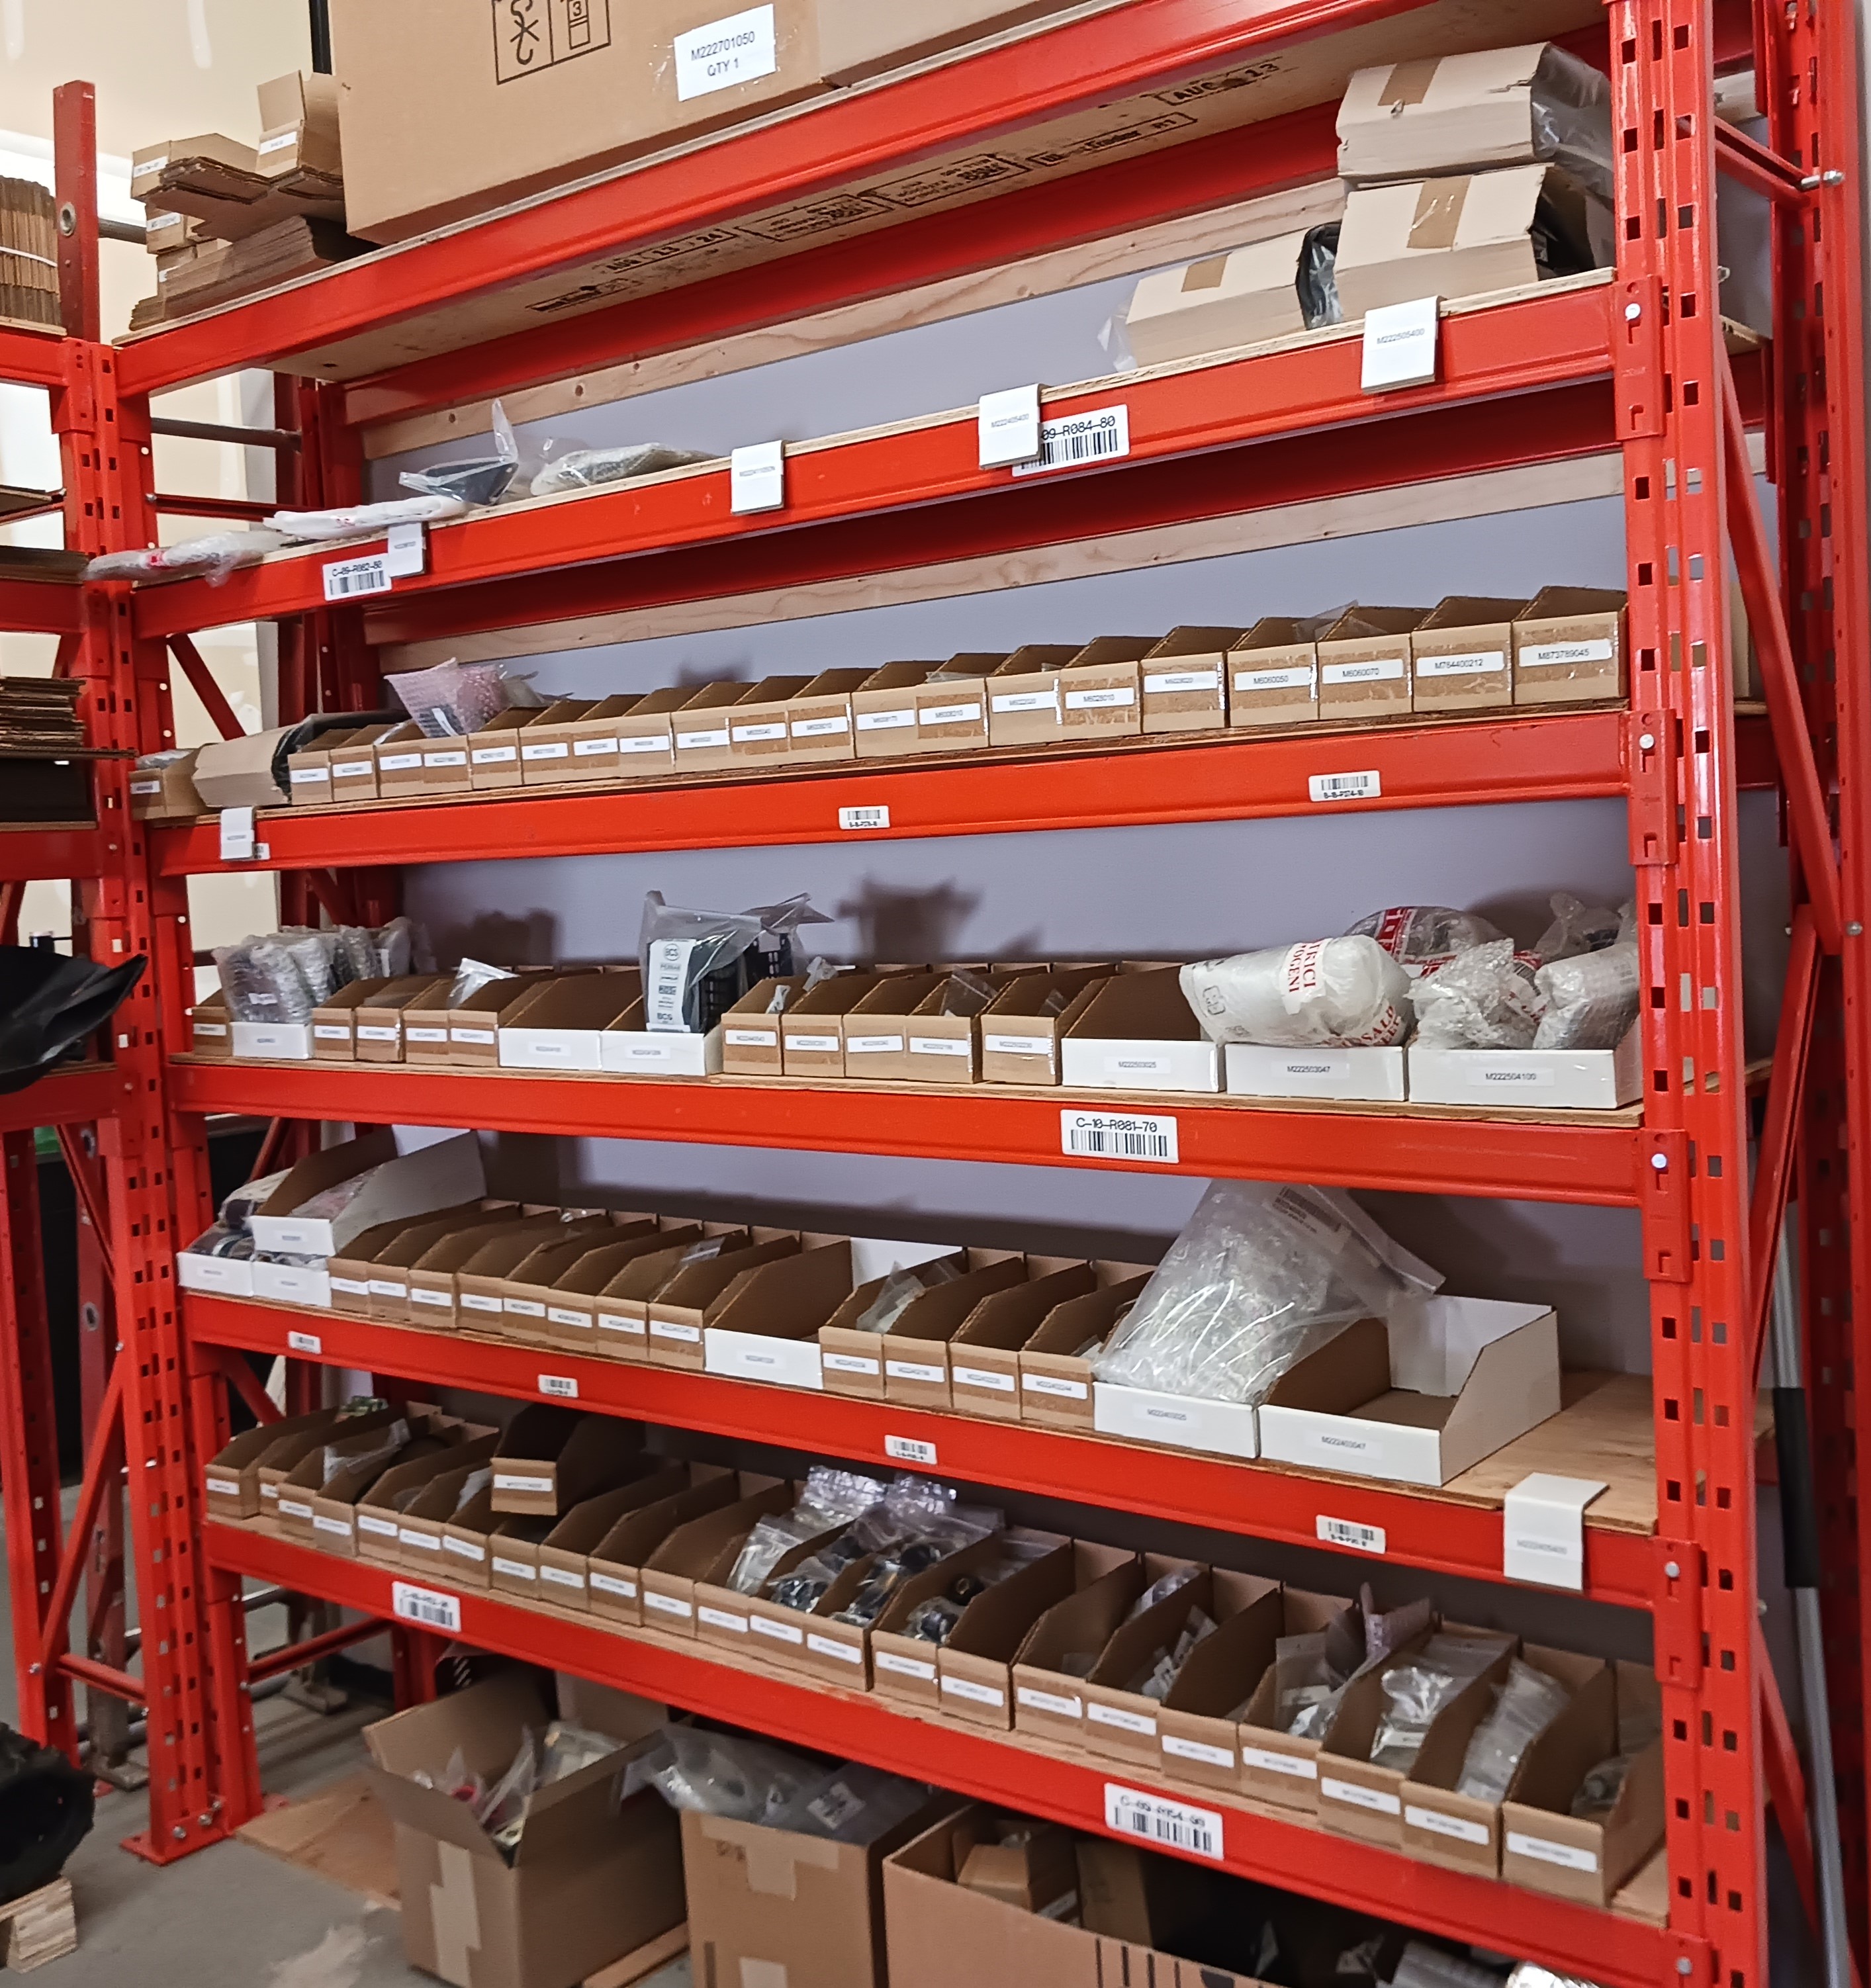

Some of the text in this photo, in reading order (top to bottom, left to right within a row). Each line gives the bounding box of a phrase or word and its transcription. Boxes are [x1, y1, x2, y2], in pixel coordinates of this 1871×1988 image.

[692, 31, 755, 61] M222701050
[707, 58, 739, 77] QTY 1
[1076, 1117, 1158, 1132] C-10-R081-70
